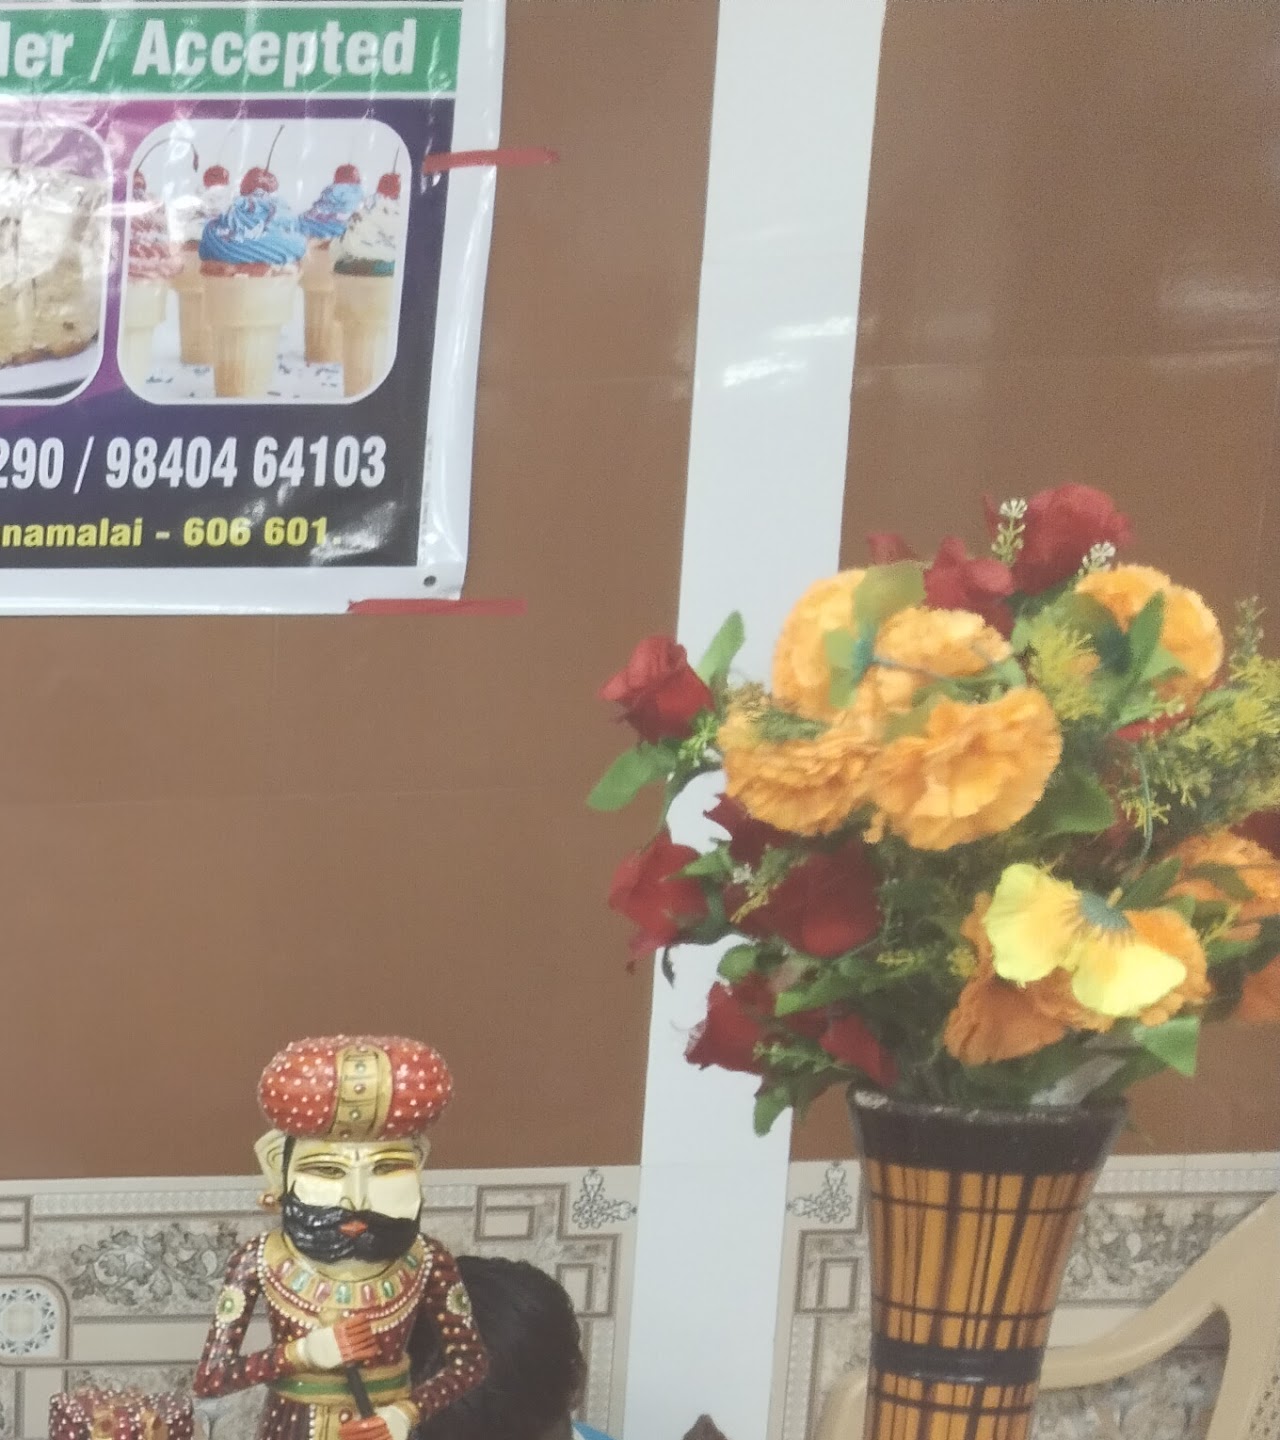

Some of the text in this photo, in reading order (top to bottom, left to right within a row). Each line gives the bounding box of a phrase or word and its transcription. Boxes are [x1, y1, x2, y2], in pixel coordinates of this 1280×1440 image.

[89, 18, 117, 83] /
[132, 18, 418, 88] Accepted
[73, 435, 95, 494] /
[105, 435, 238, 489] 98404
[252, 434, 388, 488] 64103
[183, 517, 252, 547] 606
